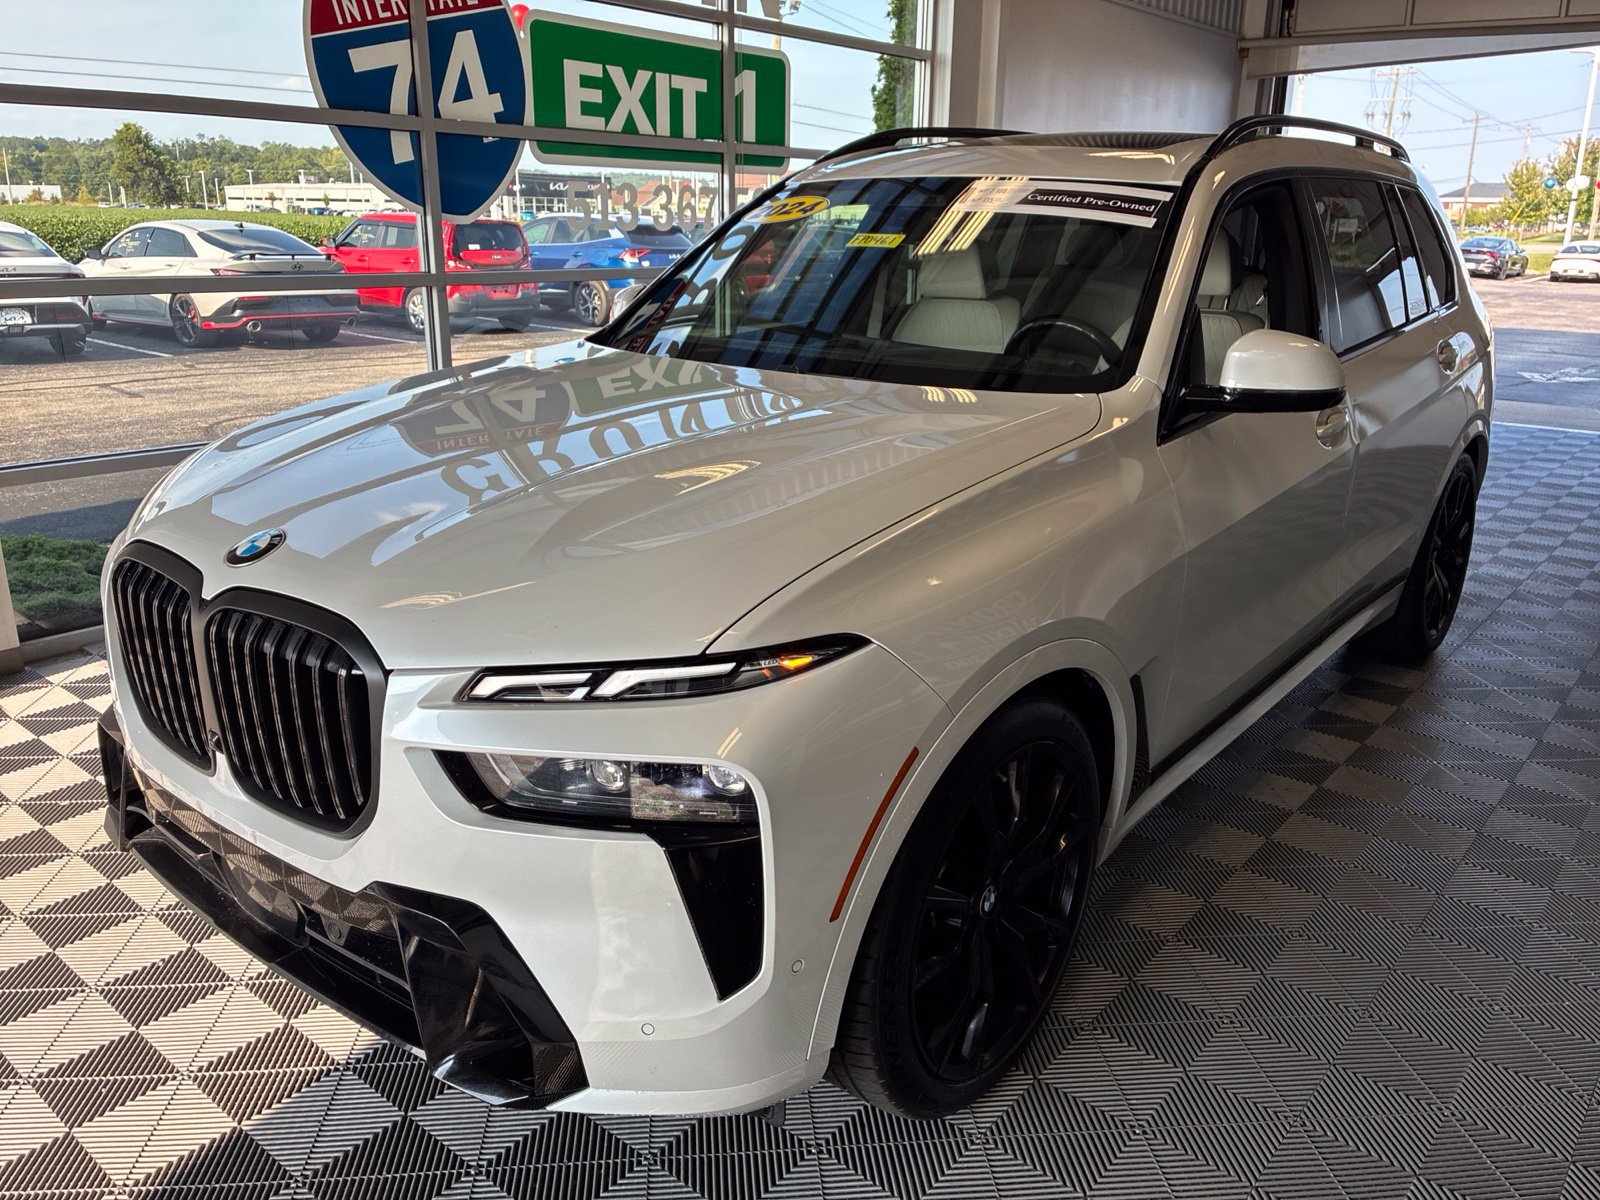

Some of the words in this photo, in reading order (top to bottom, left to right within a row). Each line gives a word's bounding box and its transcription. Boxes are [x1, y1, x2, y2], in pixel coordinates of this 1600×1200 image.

[348, 29, 505, 164] 74
[563, 58, 708, 140] EXIT
[735, 69, 757, 143] 1
[566, 181, 640, 232] 513
[652, 183, 719, 232] 367
[752, 200, 825, 219] 2024
[1027, 193, 1082, 203] Certified
[1083, 197, 1156, 212] Pre-Owned
